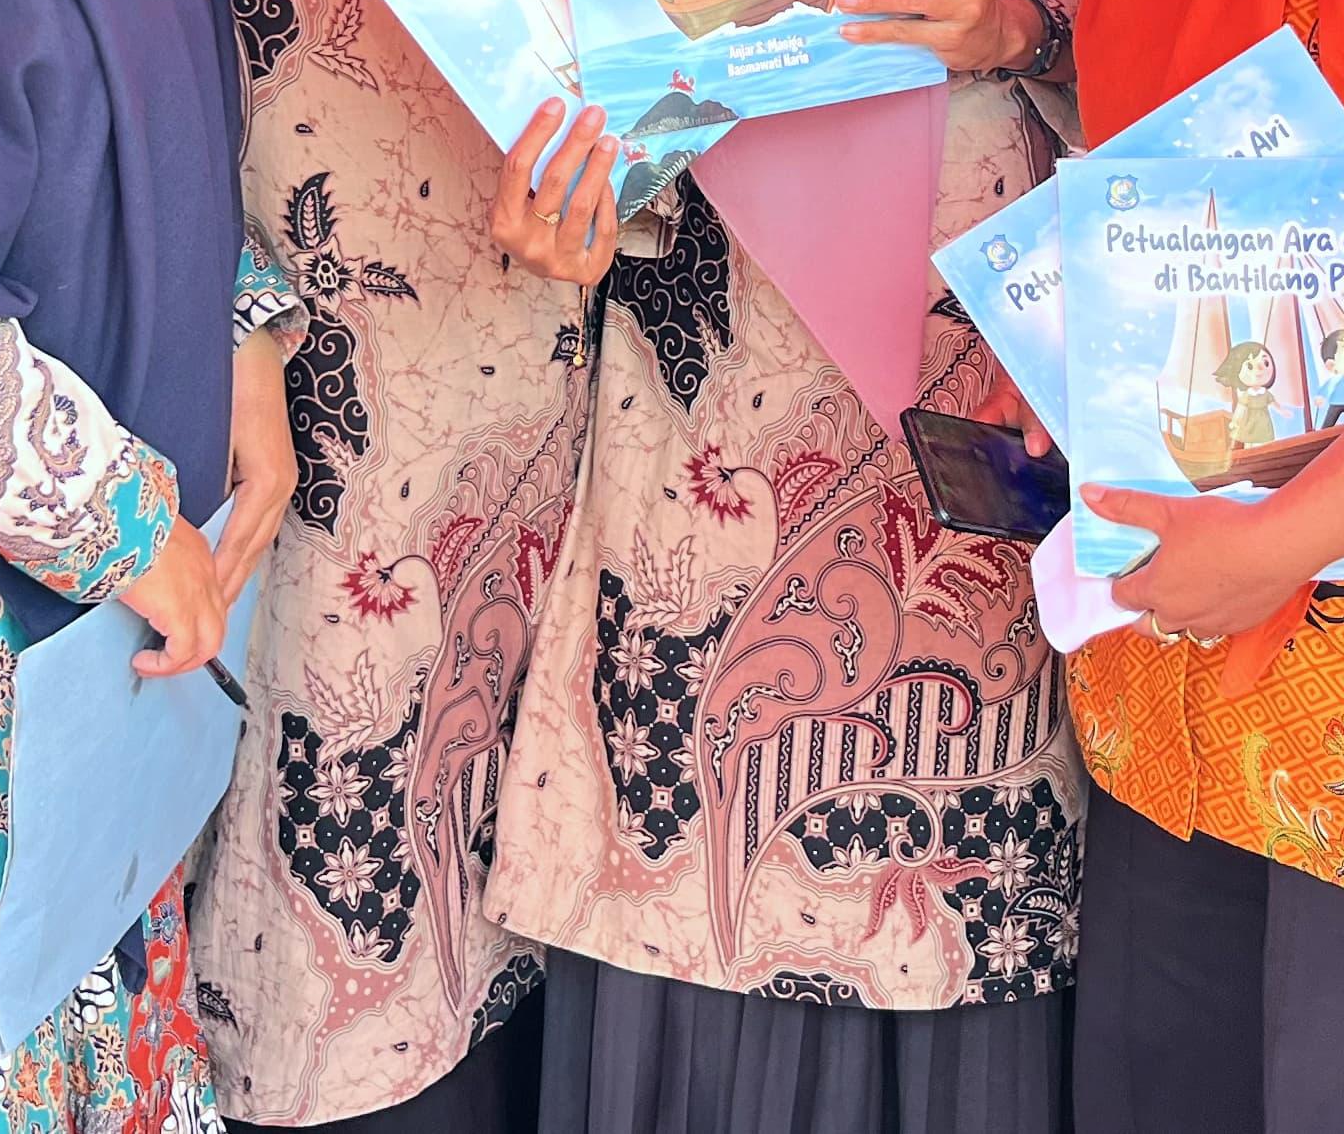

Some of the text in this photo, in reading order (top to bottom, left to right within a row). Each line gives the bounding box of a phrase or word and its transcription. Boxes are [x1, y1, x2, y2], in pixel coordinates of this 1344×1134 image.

[1250, 118, 1290, 158] Ari
[1106, 223, 1274, 260] Petualangan
[1283, 225, 1334, 254] Ara
[1006, 270, 1063, 311] Petu
[1154, 263, 1179, 293] di
[1187, 263, 1320, 300] Bantilang
